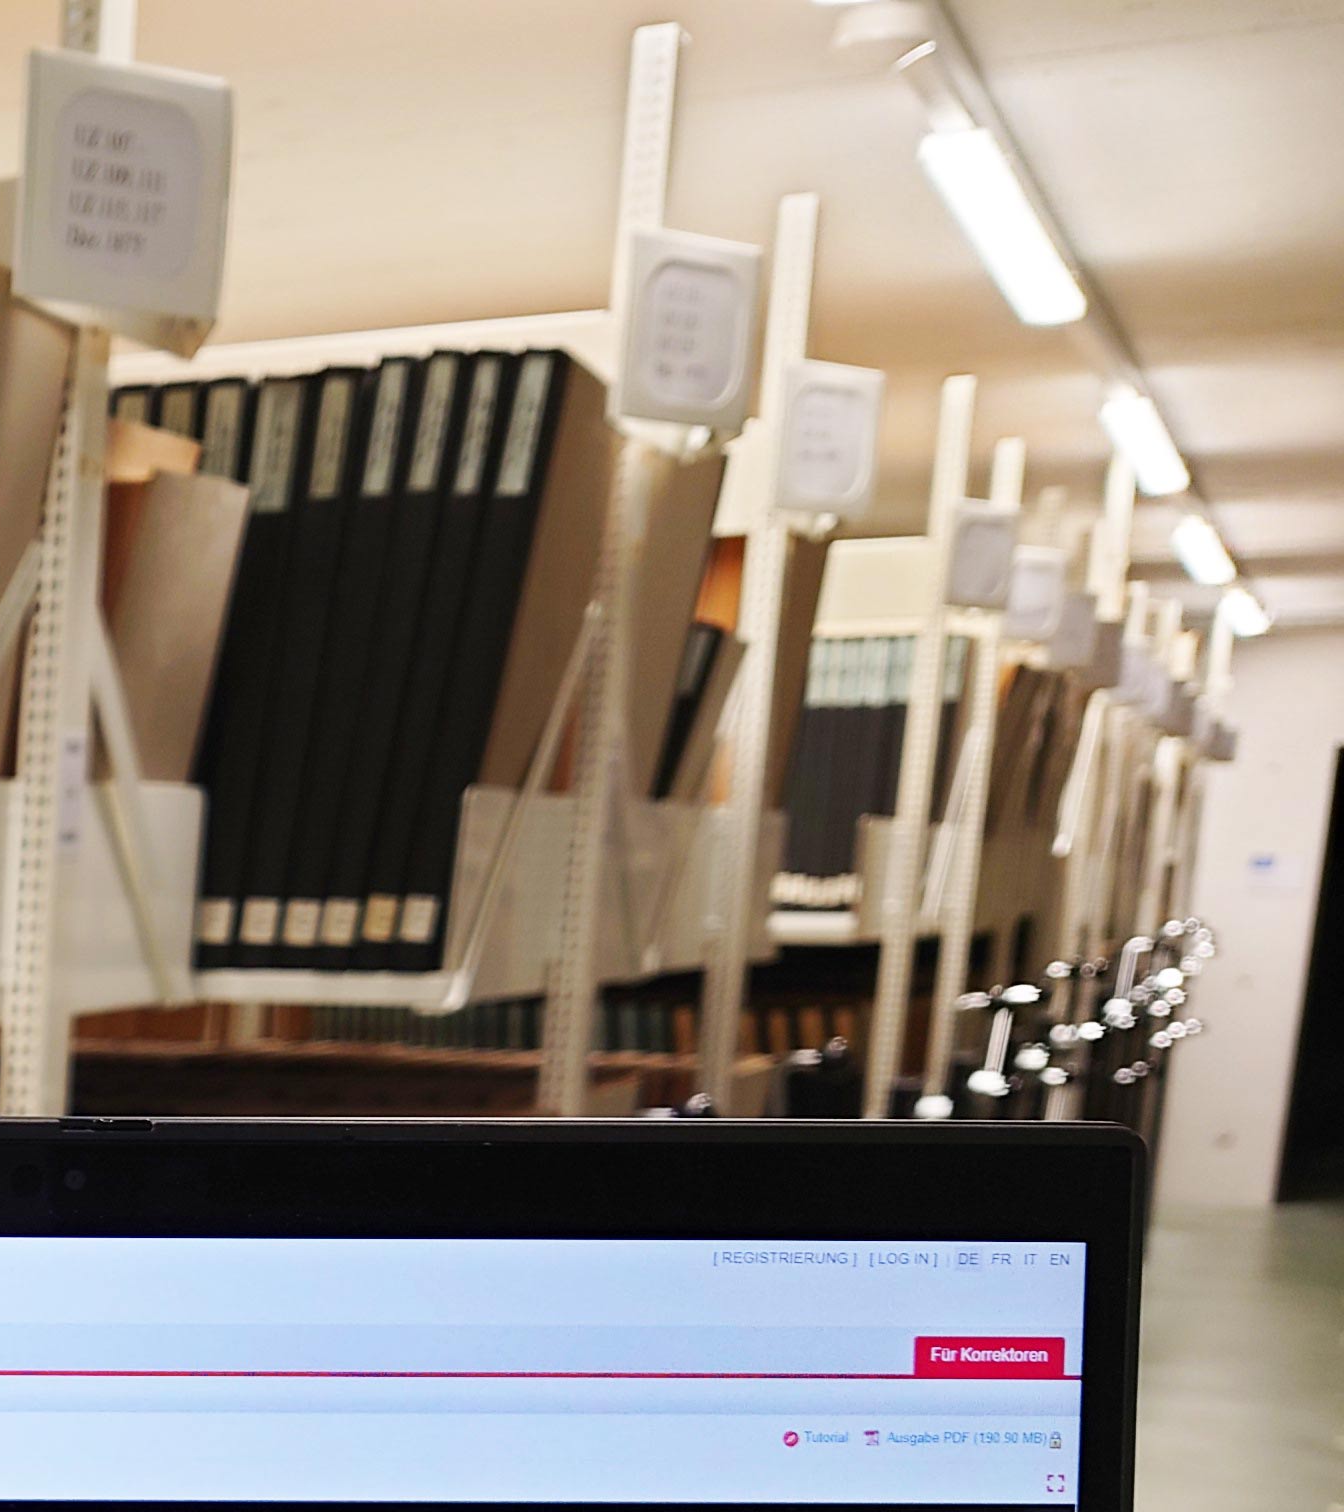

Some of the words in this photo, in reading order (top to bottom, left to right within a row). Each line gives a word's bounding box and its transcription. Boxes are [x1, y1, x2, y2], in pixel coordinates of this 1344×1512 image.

[723, 1252, 848, 1264] REGISTRIERUNG
[878, 1253, 909, 1264] LOG
[915, 1253, 928, 1264] IN
[959, 1253, 978, 1265] DE
[992, 1253, 1011, 1264] FR
[1024, 1254, 1037, 1264] IT
[1050, 1254, 1069, 1265] EN
[931, 1346, 958, 1361] Für
[960, 1347, 1048, 1362] Korrektoren
[804, 1431, 848, 1443] Tutorial
[888, 1432, 939, 1446] Ausgabe
[944, 1432, 969, 1444] PDF
[1023, 1431, 1047, 1446] MB)
